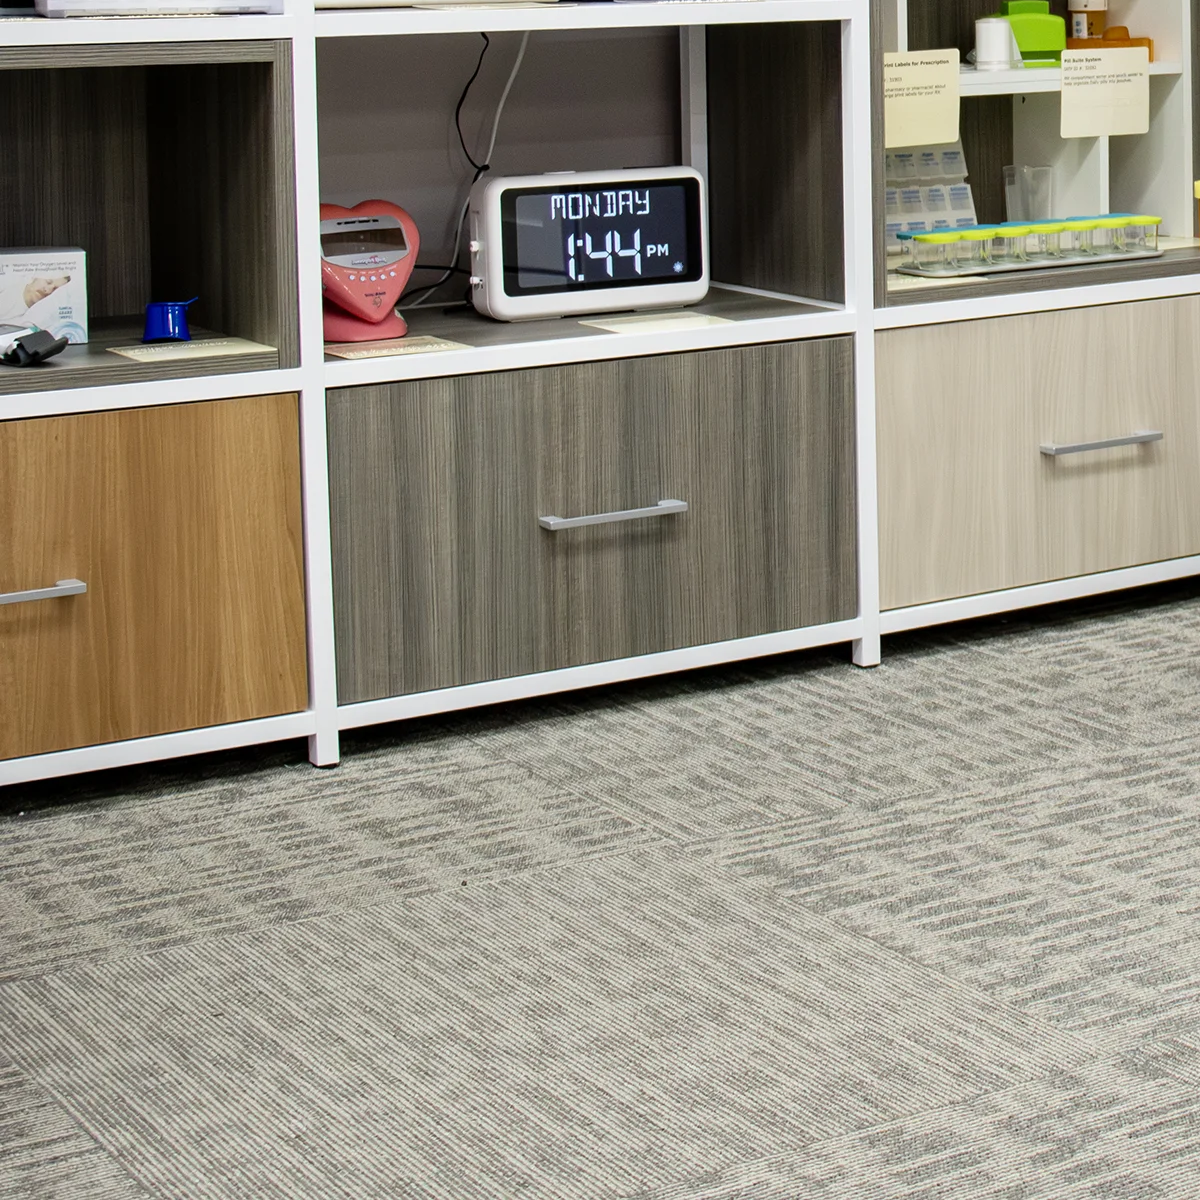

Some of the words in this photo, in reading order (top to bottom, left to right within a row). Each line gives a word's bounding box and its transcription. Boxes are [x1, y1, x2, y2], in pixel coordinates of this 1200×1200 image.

[551, 190, 650, 220] MONDAY
[568, 228, 641, 281] 1:44
[646, 243, 669, 258] PM
